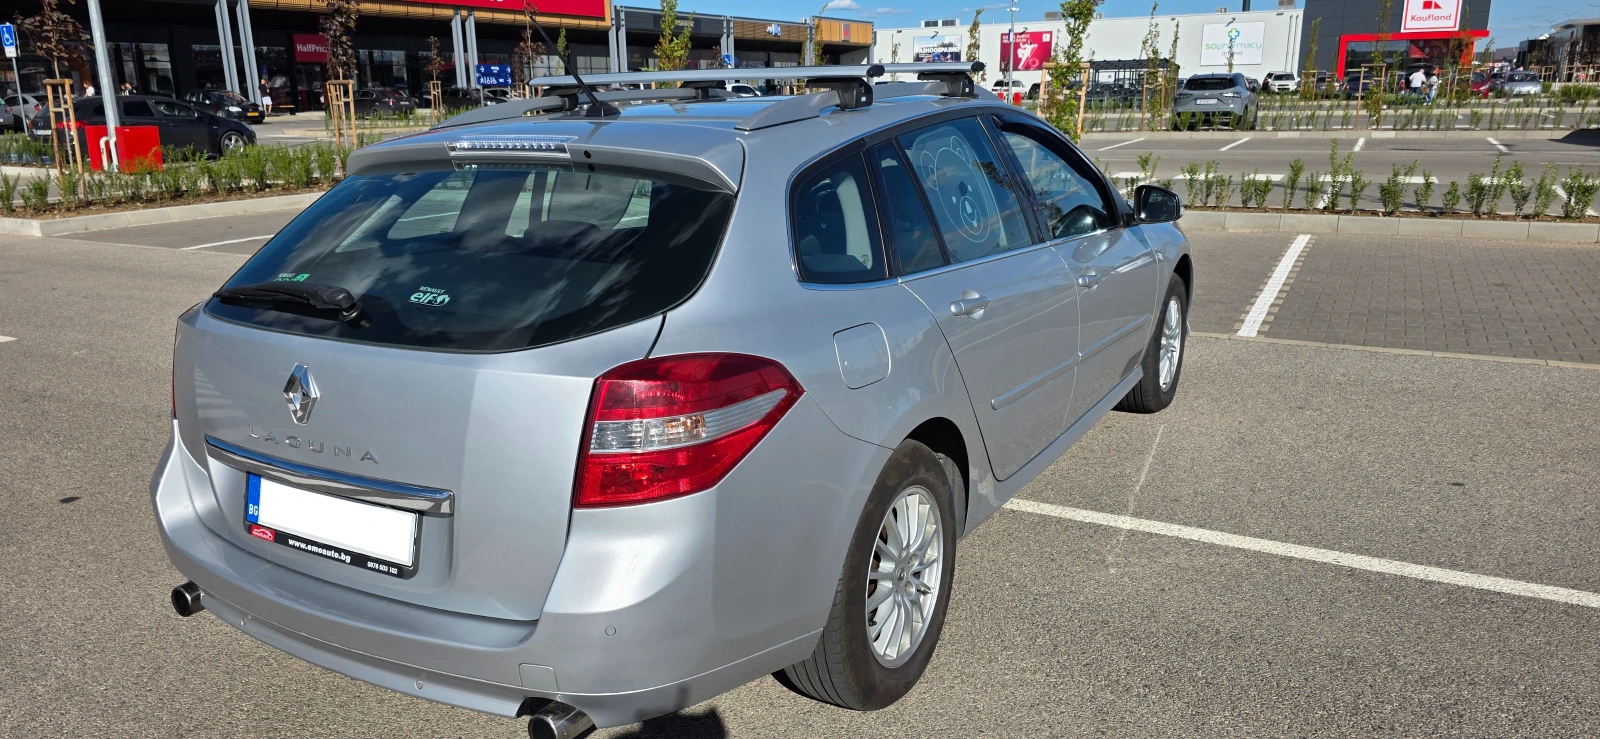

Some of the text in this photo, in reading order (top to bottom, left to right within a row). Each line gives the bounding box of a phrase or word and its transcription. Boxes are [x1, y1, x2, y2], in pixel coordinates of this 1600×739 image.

[1411, 13, 1452, 22] Kaufland
[297, 43, 327, 53] HalfPric
[419, 285, 446, 294] RENAULT
[248, 425, 379, 464] LAGUNA
[248, 503, 259, 516] BG
[288, 538, 351, 563] www.emoauto.bg
